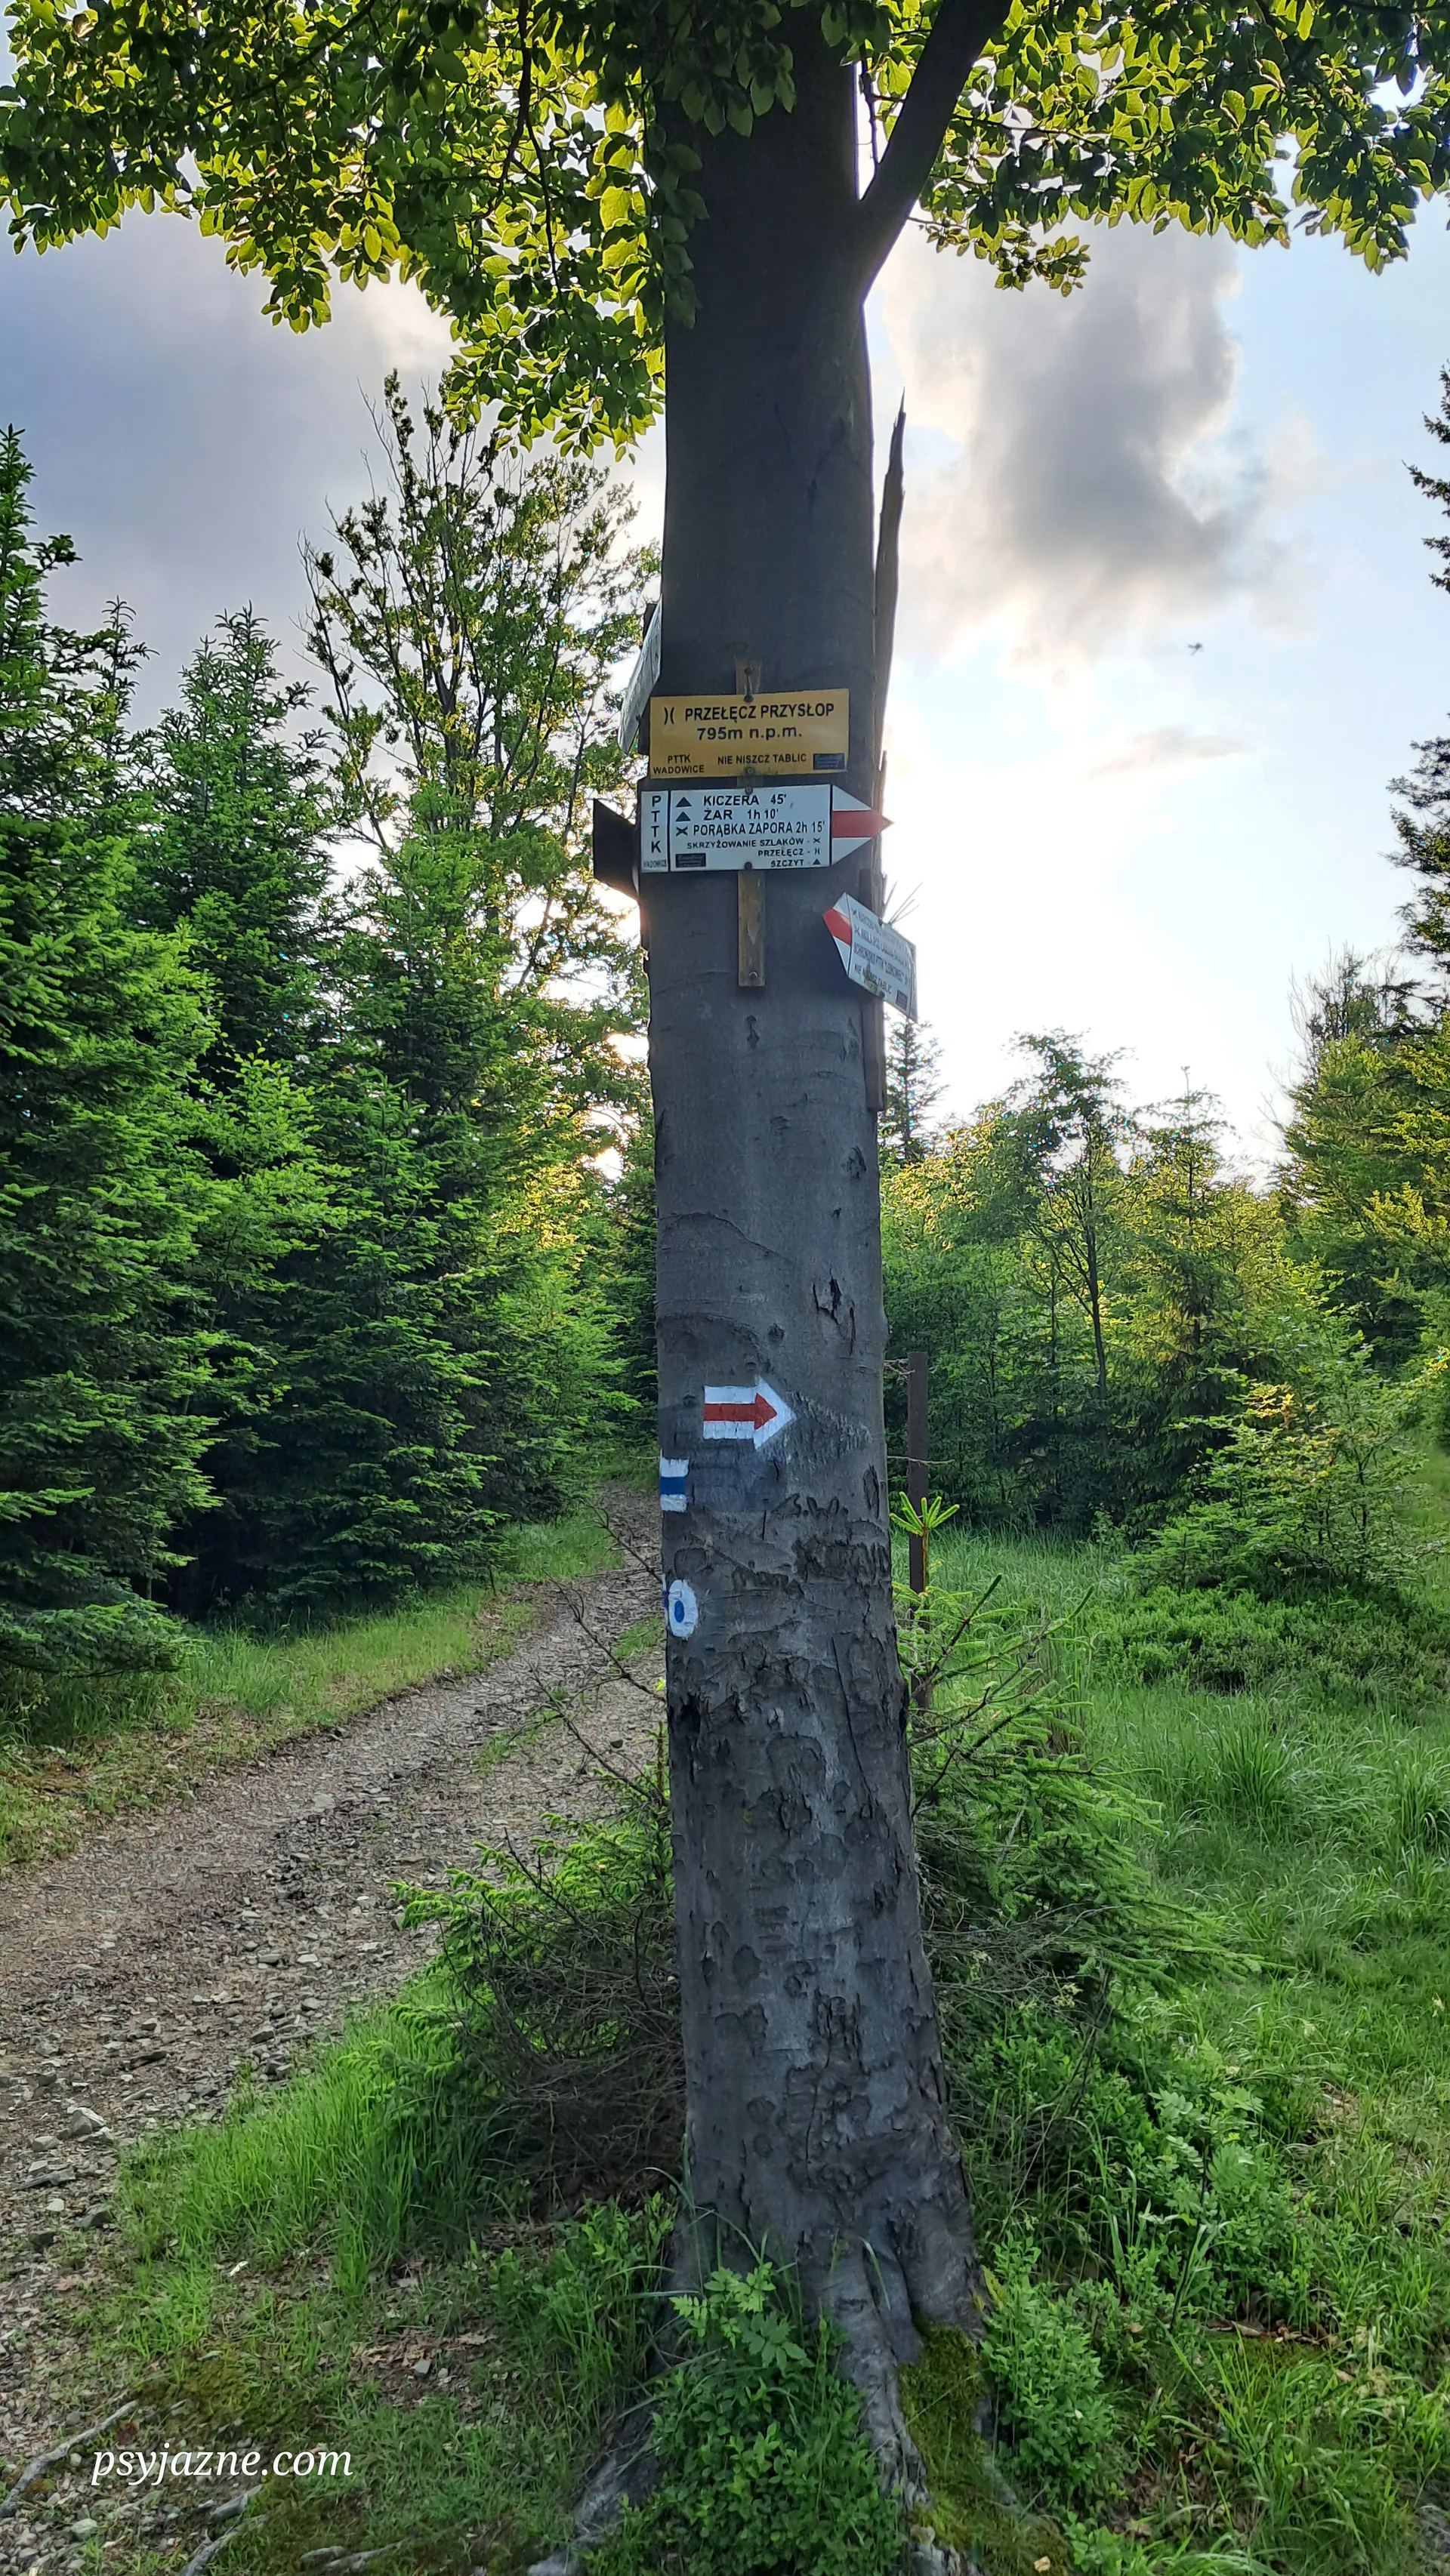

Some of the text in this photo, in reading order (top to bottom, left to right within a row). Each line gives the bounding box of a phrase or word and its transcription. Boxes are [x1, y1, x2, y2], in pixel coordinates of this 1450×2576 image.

[685, 703, 835, 723] PRZEŁĘCZ PRZYSŁOP
[697, 726, 802, 741] 795m n.p.m.
[668, 754, 691, 763] PTTK
[717, 756, 733, 764] NIE
[736, 754, 770, 764] NISZCZ
[773, 753, 807, 763] TABLIC
[653, 764, 704, 774] WADOWICE
[703, 793, 787, 806] KICZERA 45'
[703, 808, 779, 821] ŻAR 1h 10'
[693, 821, 825, 837] PORĄBKA ZAPORA 2h 15'
[686, 837, 804, 849] SKRZYŻOWANIE SZLAKÓW
[757, 849, 804, 857] PRZEŁĘCZ
[770, 858, 804, 867] SZCZYT
